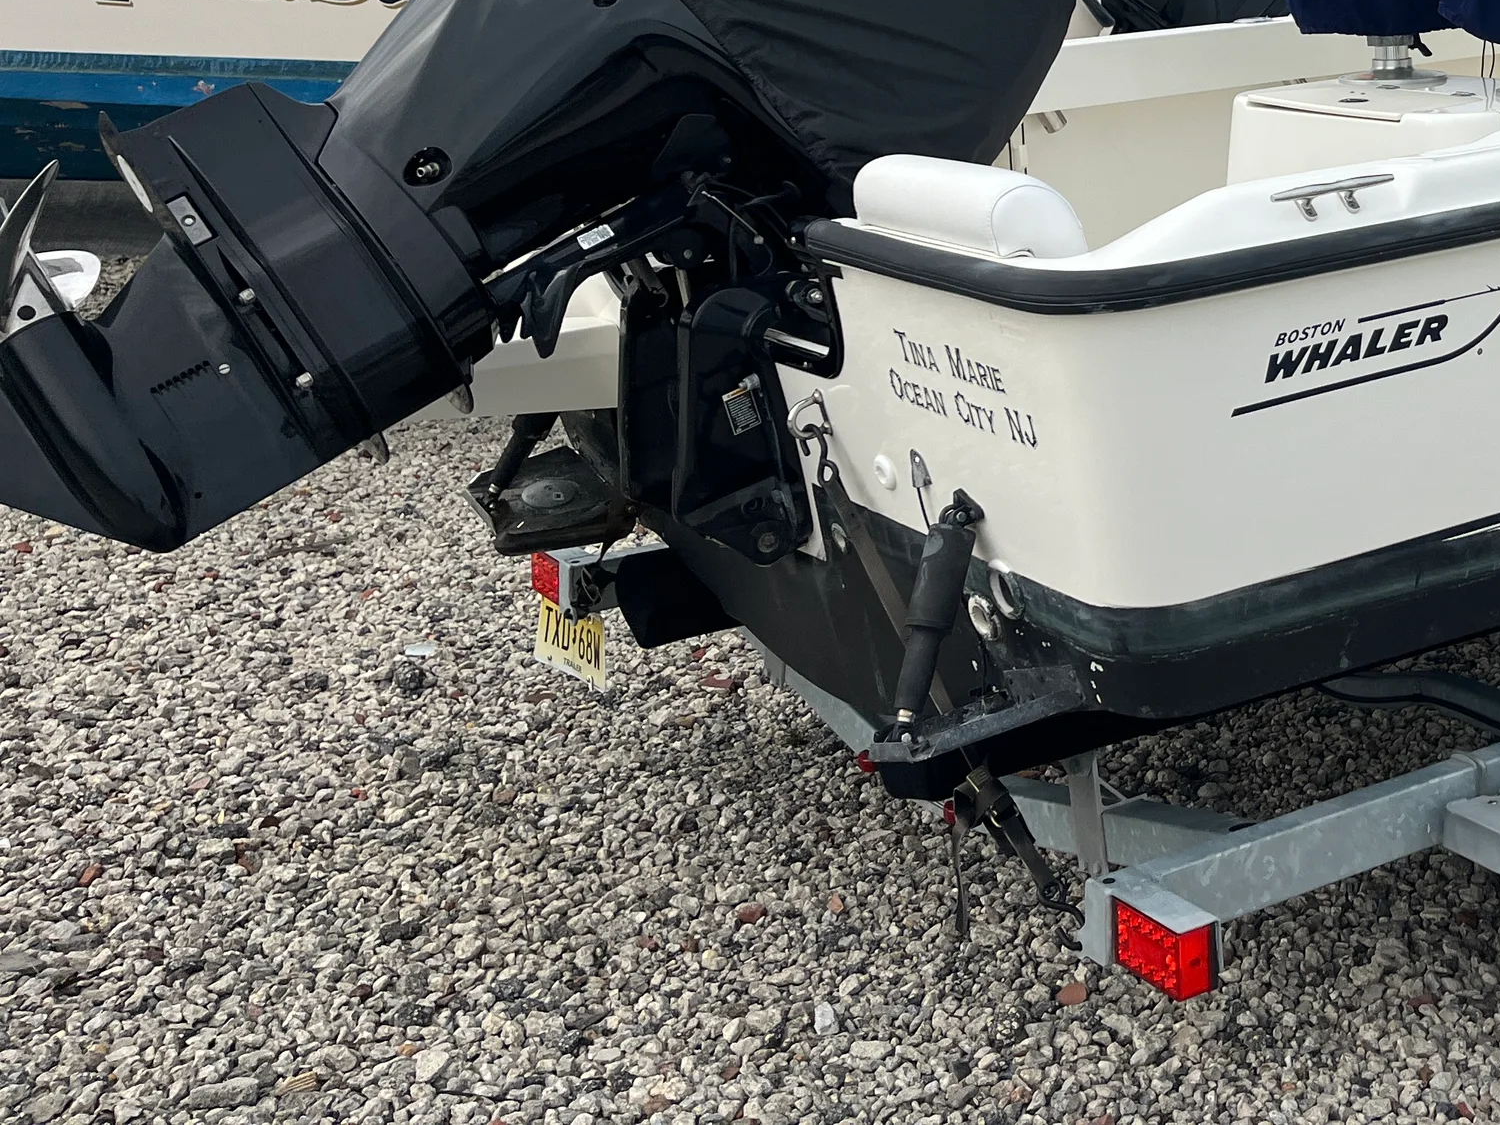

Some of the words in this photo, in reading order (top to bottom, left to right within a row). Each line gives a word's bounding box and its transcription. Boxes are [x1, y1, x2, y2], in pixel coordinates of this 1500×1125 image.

[1264, 314, 1449, 384] WHALER
[1274, 319, 1346, 347] BOSTON
[1003, 406, 1039, 449] NJ
[563, 657, 583, 674] TRAILER
